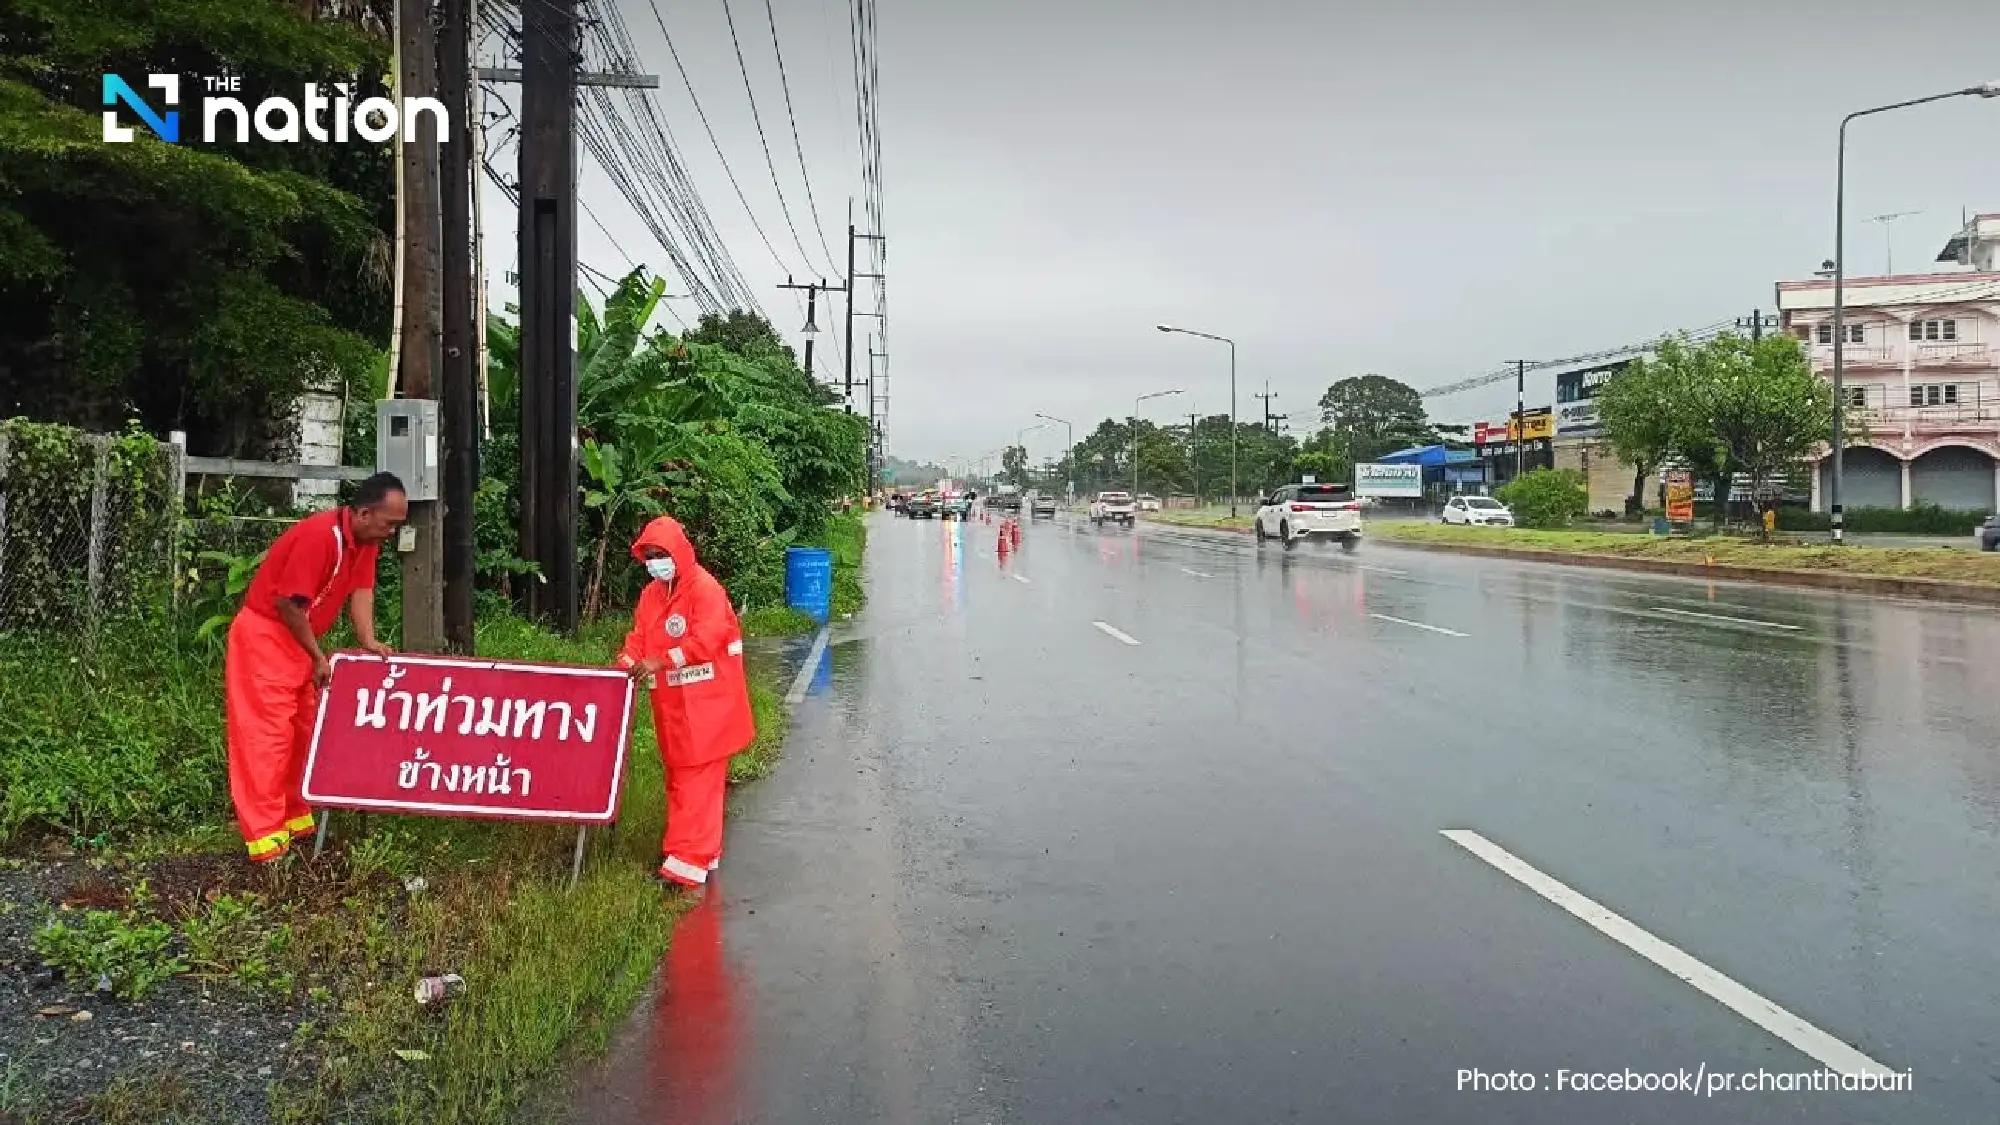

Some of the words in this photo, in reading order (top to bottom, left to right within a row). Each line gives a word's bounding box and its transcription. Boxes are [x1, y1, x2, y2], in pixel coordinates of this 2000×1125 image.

[354, 664, 598, 743] น้ำท่วมทาง
[398, 747, 532, 796] ข้างหน้า
